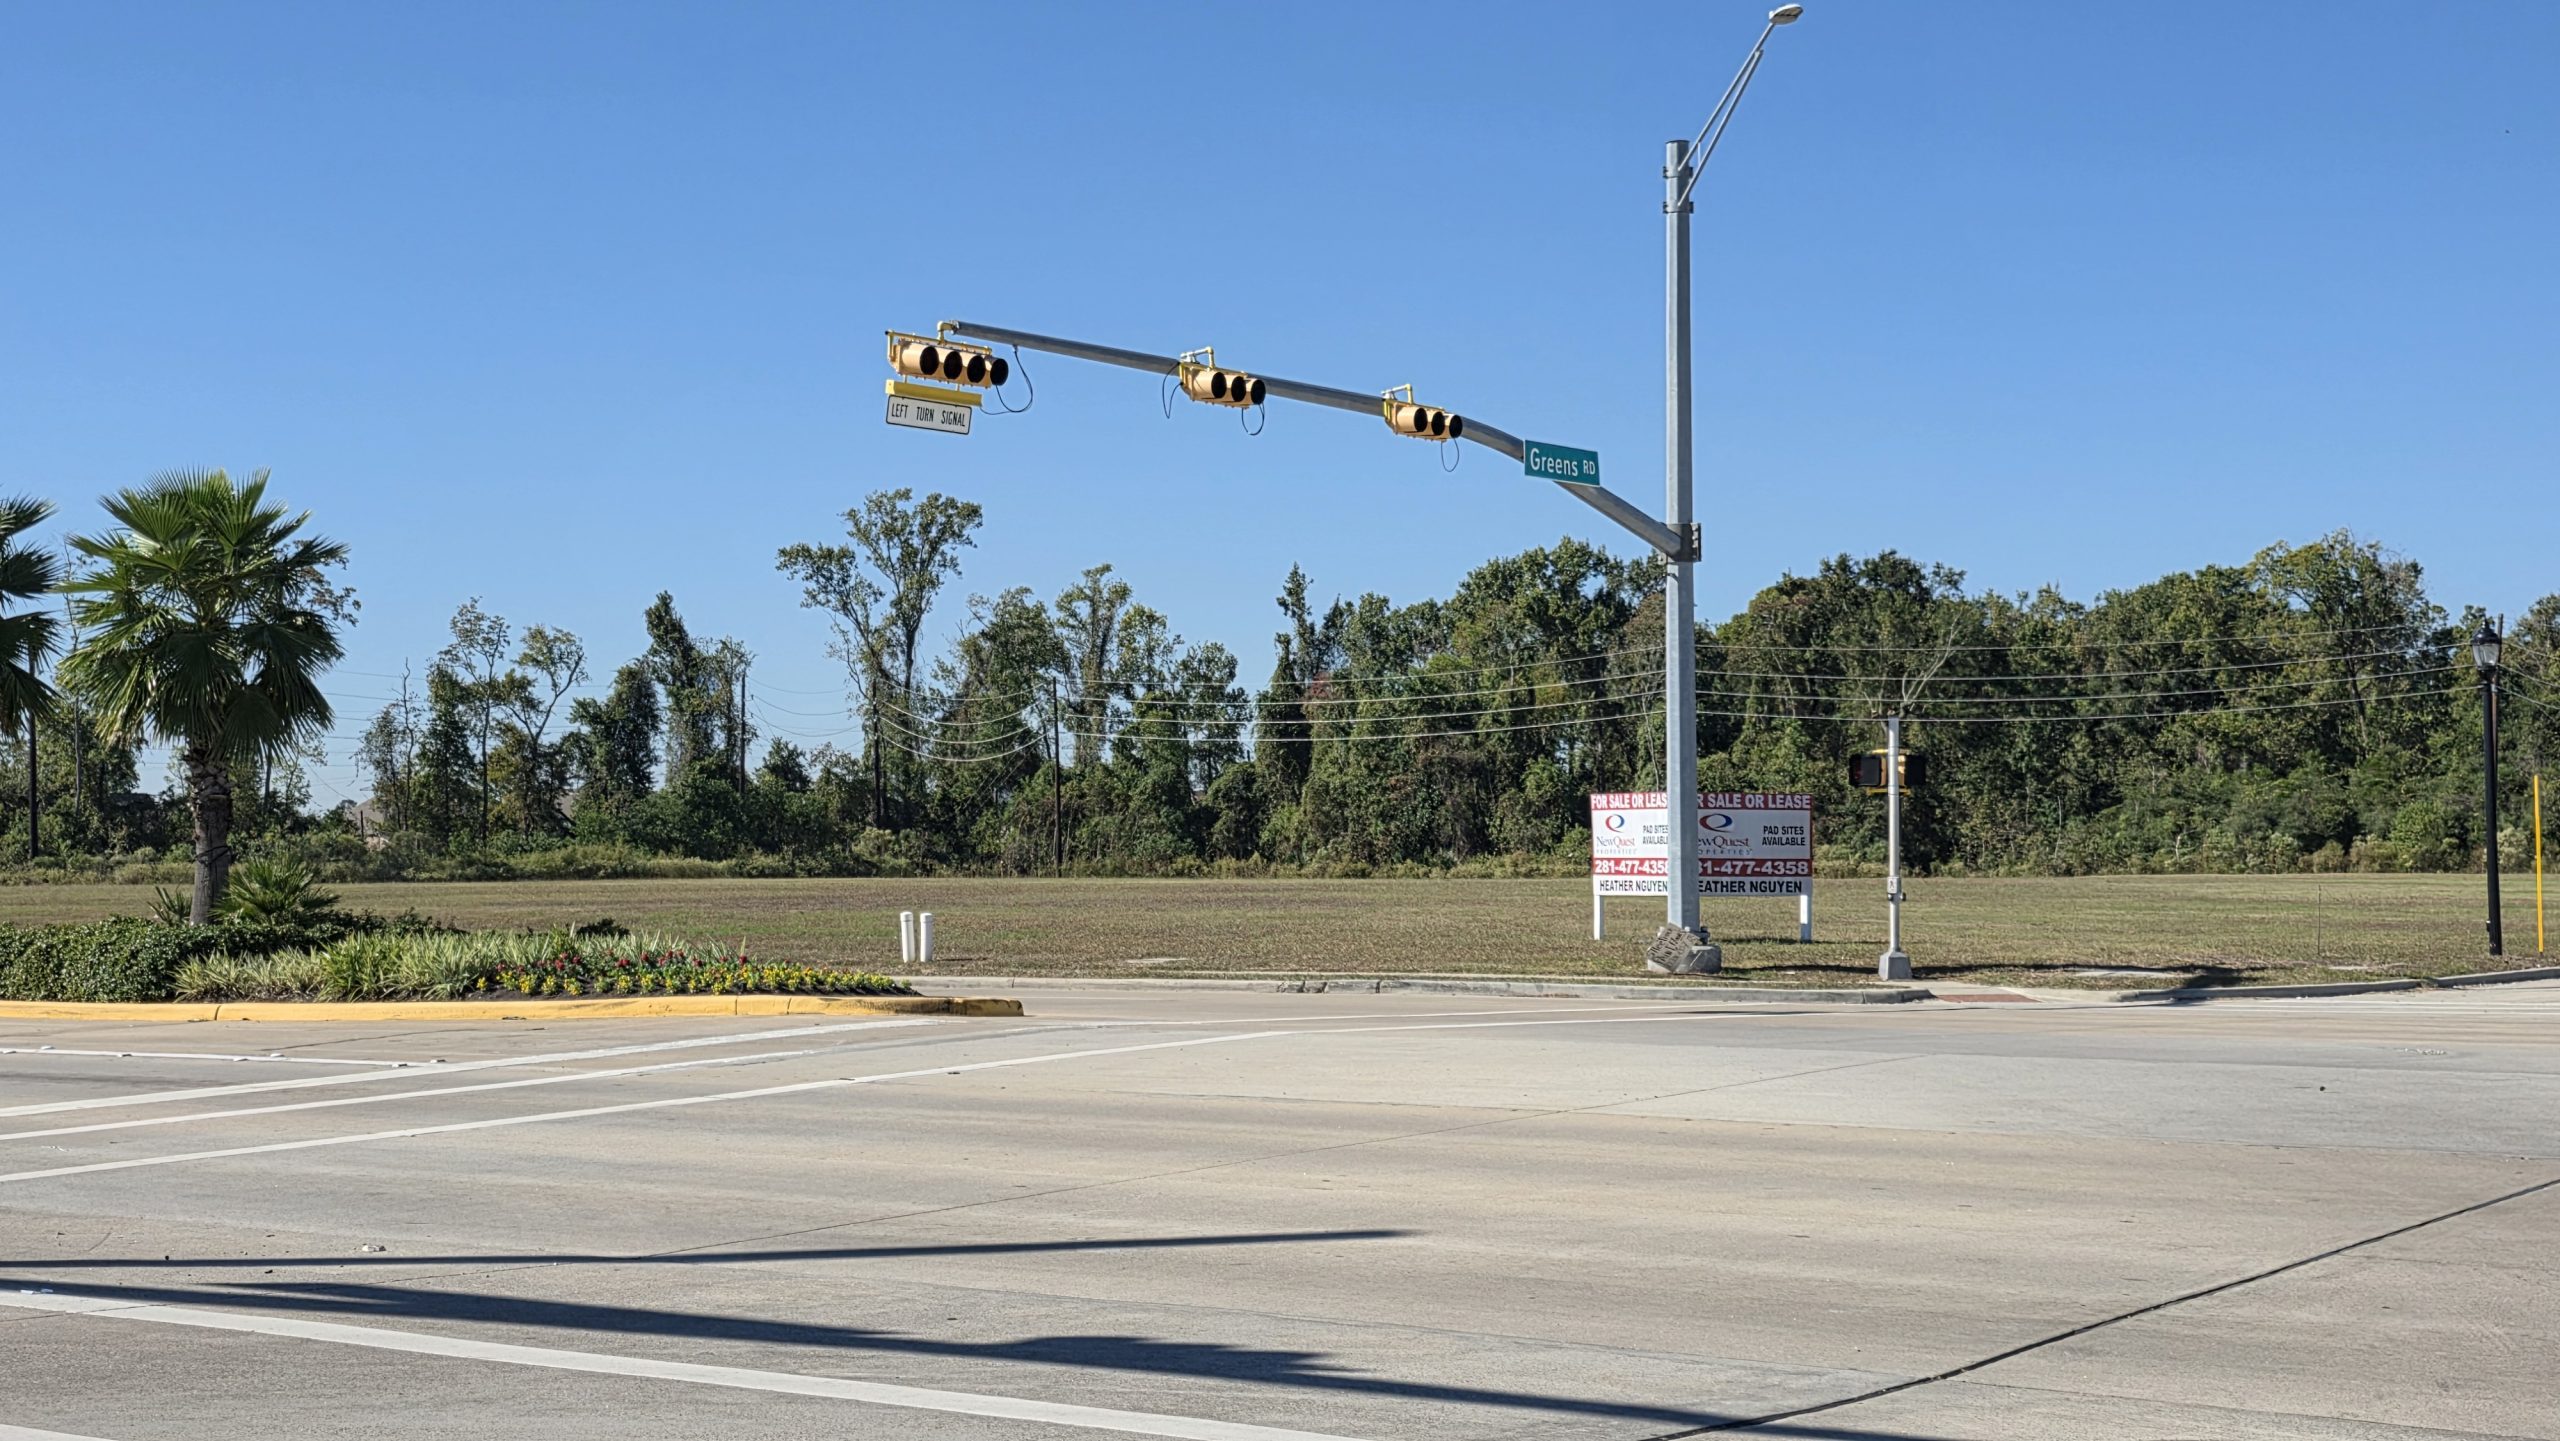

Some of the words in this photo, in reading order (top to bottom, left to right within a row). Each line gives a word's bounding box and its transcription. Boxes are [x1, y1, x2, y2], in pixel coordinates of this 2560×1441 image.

[891, 403, 908, 419] LEFT
[916, 406, 935, 423] TURN
[941, 410, 966, 427] SIGNAL
[1530, 447, 1578, 477] Greens
[1583, 460, 1596, 475] RD
[1591, 794, 1608, 809] FOR
[1608, 794, 1631, 809] SALE
[1631, 794, 1645, 808] OR
[1645, 793, 1668, 808] LEAS
[1707, 794, 1742, 808] SALE
[1745, 794, 1764, 808] OR
[1768, 794, 1812, 809] LEASE
[1642, 825, 1653, 834] PAD
[1763, 825, 1779, 835] PAD
[1781, 825, 1804, 835] SITES
[1596, 836, 1635, 848] NewQuest
[1642, 836, 1669, 845] AVAILABL
[1698, 835, 1750, 849] ewQuest
[1762, 837, 1806, 846] AVAILABLE
[1600, 880, 1634, 892] HEATHER
[1636, 880, 1668, 892] NGUYEN
[1698, 881, 1746, 893] EATHER
[1750, 881, 1802, 893] NGUYEN
